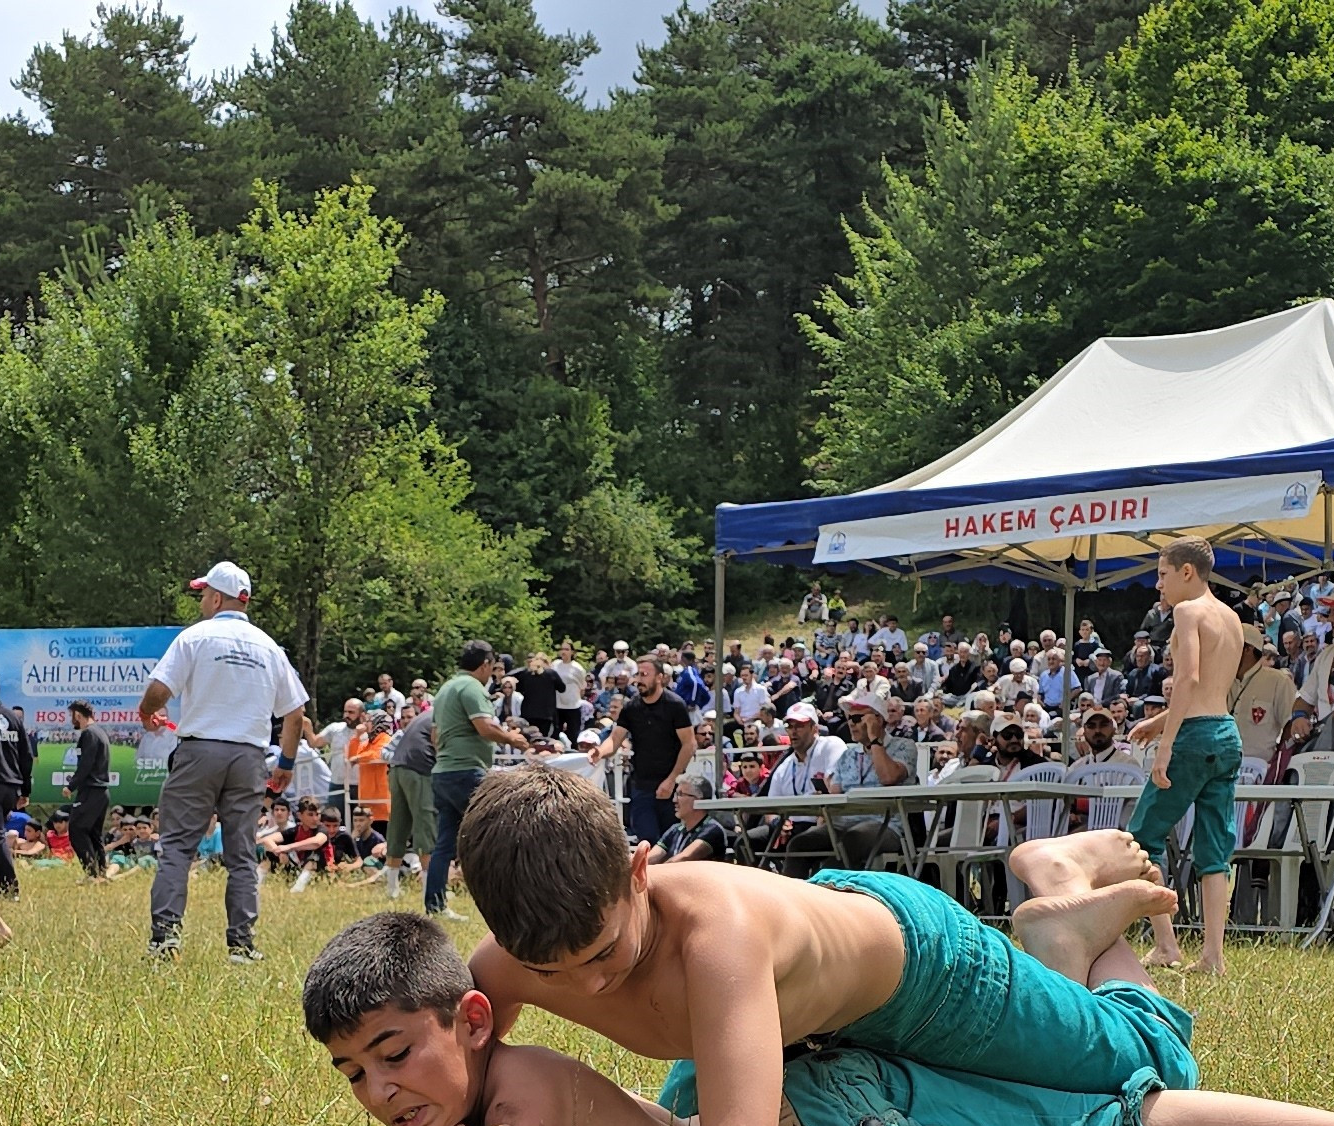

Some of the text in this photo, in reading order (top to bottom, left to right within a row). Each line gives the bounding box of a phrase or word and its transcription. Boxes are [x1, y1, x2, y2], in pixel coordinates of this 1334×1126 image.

[945, 497, 1149, 538] HAKEM ÇADIRI
[48, 639, 64, 659] 6.
